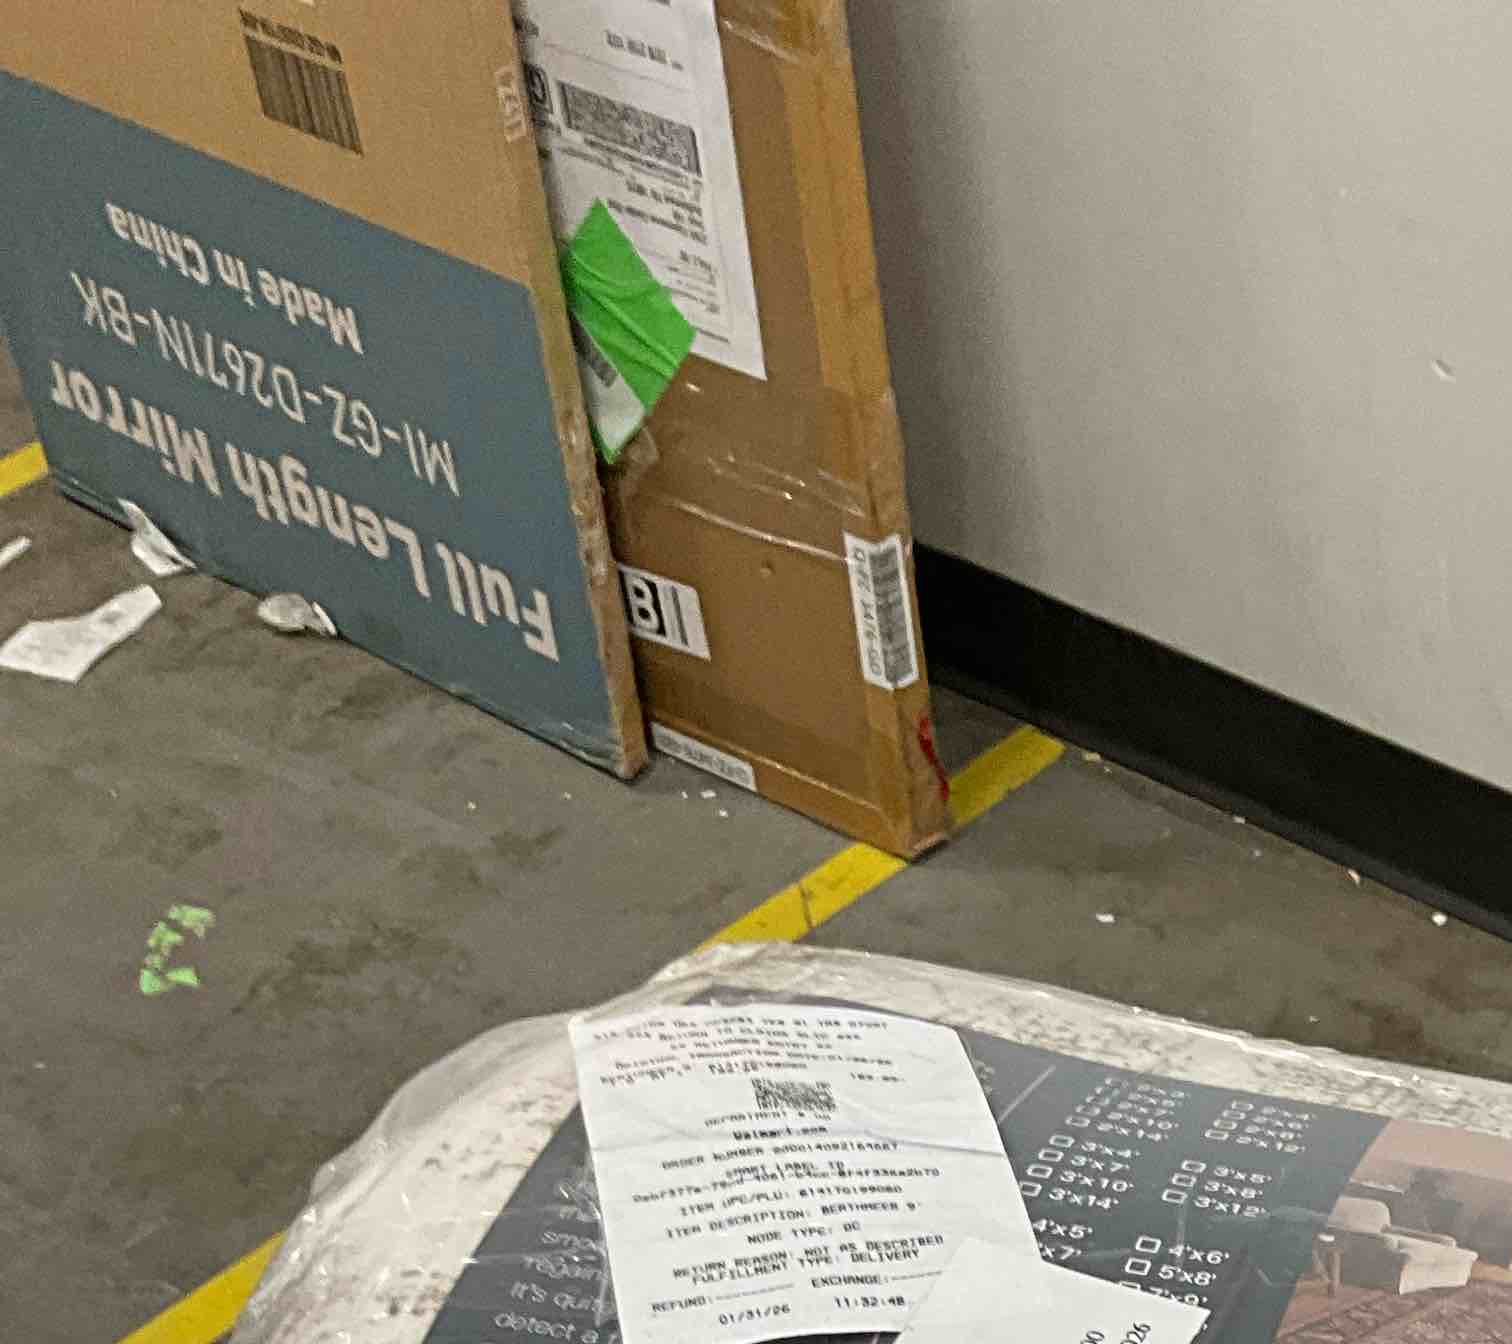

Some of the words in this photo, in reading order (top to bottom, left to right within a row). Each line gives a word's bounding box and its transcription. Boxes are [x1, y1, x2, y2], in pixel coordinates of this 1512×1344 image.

[105, 202, 209, 285] China
[214, 249, 256, 309] in
[256, 267, 364, 355] Made
[50, 360, 222, 496] Mirror
[225, 442, 430, 598] Length
[435, 542, 559, 663] Full
[660, 1154, 704, 1171] ORDER
[711, 1147, 764, 1163] NUMBER
[1060, 1170, 1135, 1192] 3'x10'
[680, 1201, 714, 1217] ITEM
[1049, 1188, 1119, 1210] 3'x14'
[665, 1223, 702, 1239] ITEM
[709, 1208, 811, 1232] DESCRIPTION:
[747, 1231, 782, 1245] NODE
[791, 1226, 832, 1239] TYPE:
[672, 1260, 726, 1279] RETURN
[804, 1245, 830, 1257] NOT
[839, 1241, 858, 1252] AS
[865, 1234, 944, 1252] DESCRIBED
[1033, 1218, 1093, 1239] 4'x5'
[1169, 1245, 1230, 1265] 4'x6'
[691, 1261, 789, 1286] FULFILLMENT
[850, 1249, 920, 1264] DELIVERY
[1158, 1264, 1217, 1287] 5'x8'
[493, 1312, 576, 1341] detect
[718, 1303, 791, 1326] 01/31/26
